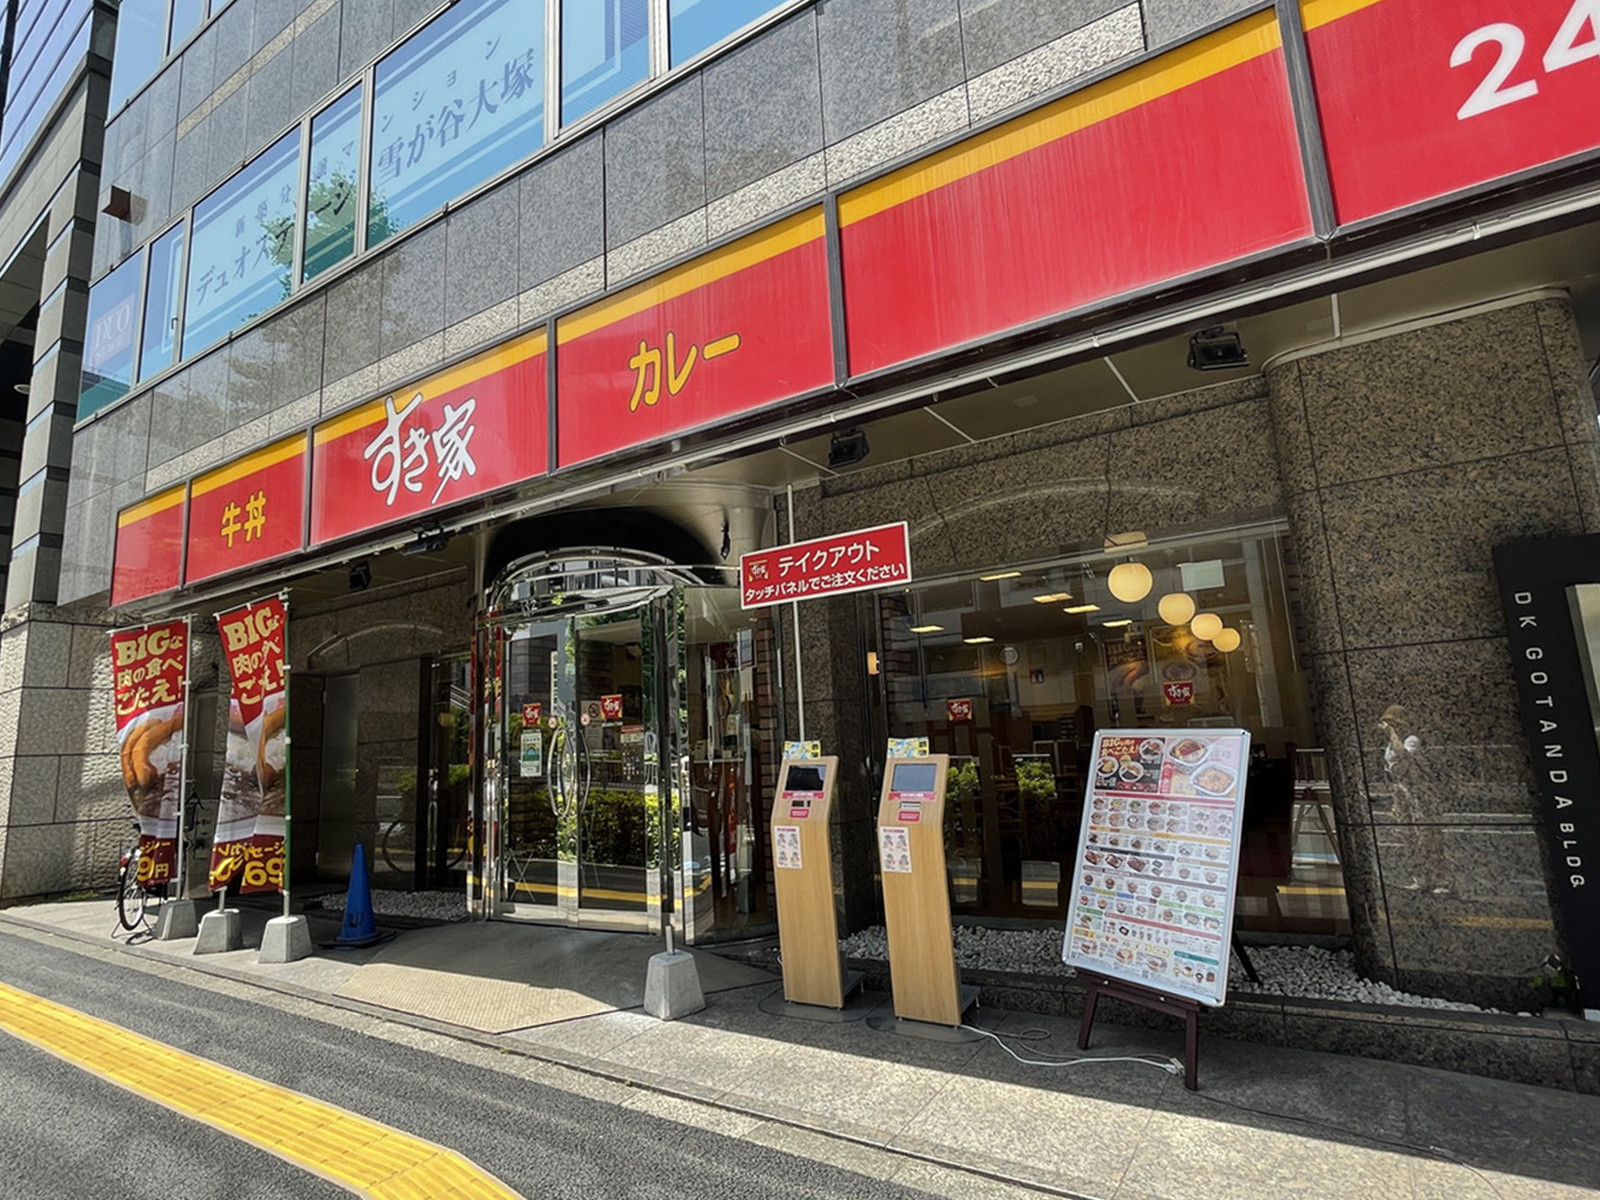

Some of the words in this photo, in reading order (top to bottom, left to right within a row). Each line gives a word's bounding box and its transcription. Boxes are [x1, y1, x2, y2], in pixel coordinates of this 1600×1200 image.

[1448, 0, 1600, 122] 24
[627, 330, 742, 413] カレー
[363, 391, 478, 507] すき家
[219, 489, 268, 548] 牛丼
[778, 539, 880, 578] テイクアウト
[744, 562, 906, 602] タッチパネルでご注文ください
[1514, 591, 1538, 629] DK
[114, 628, 184, 667] BIGな
[116, 654, 184, 691] 肉の食べ
[117, 675, 183, 716] ごたえ!
[1525, 646, 1574, 810] GOTANDA
